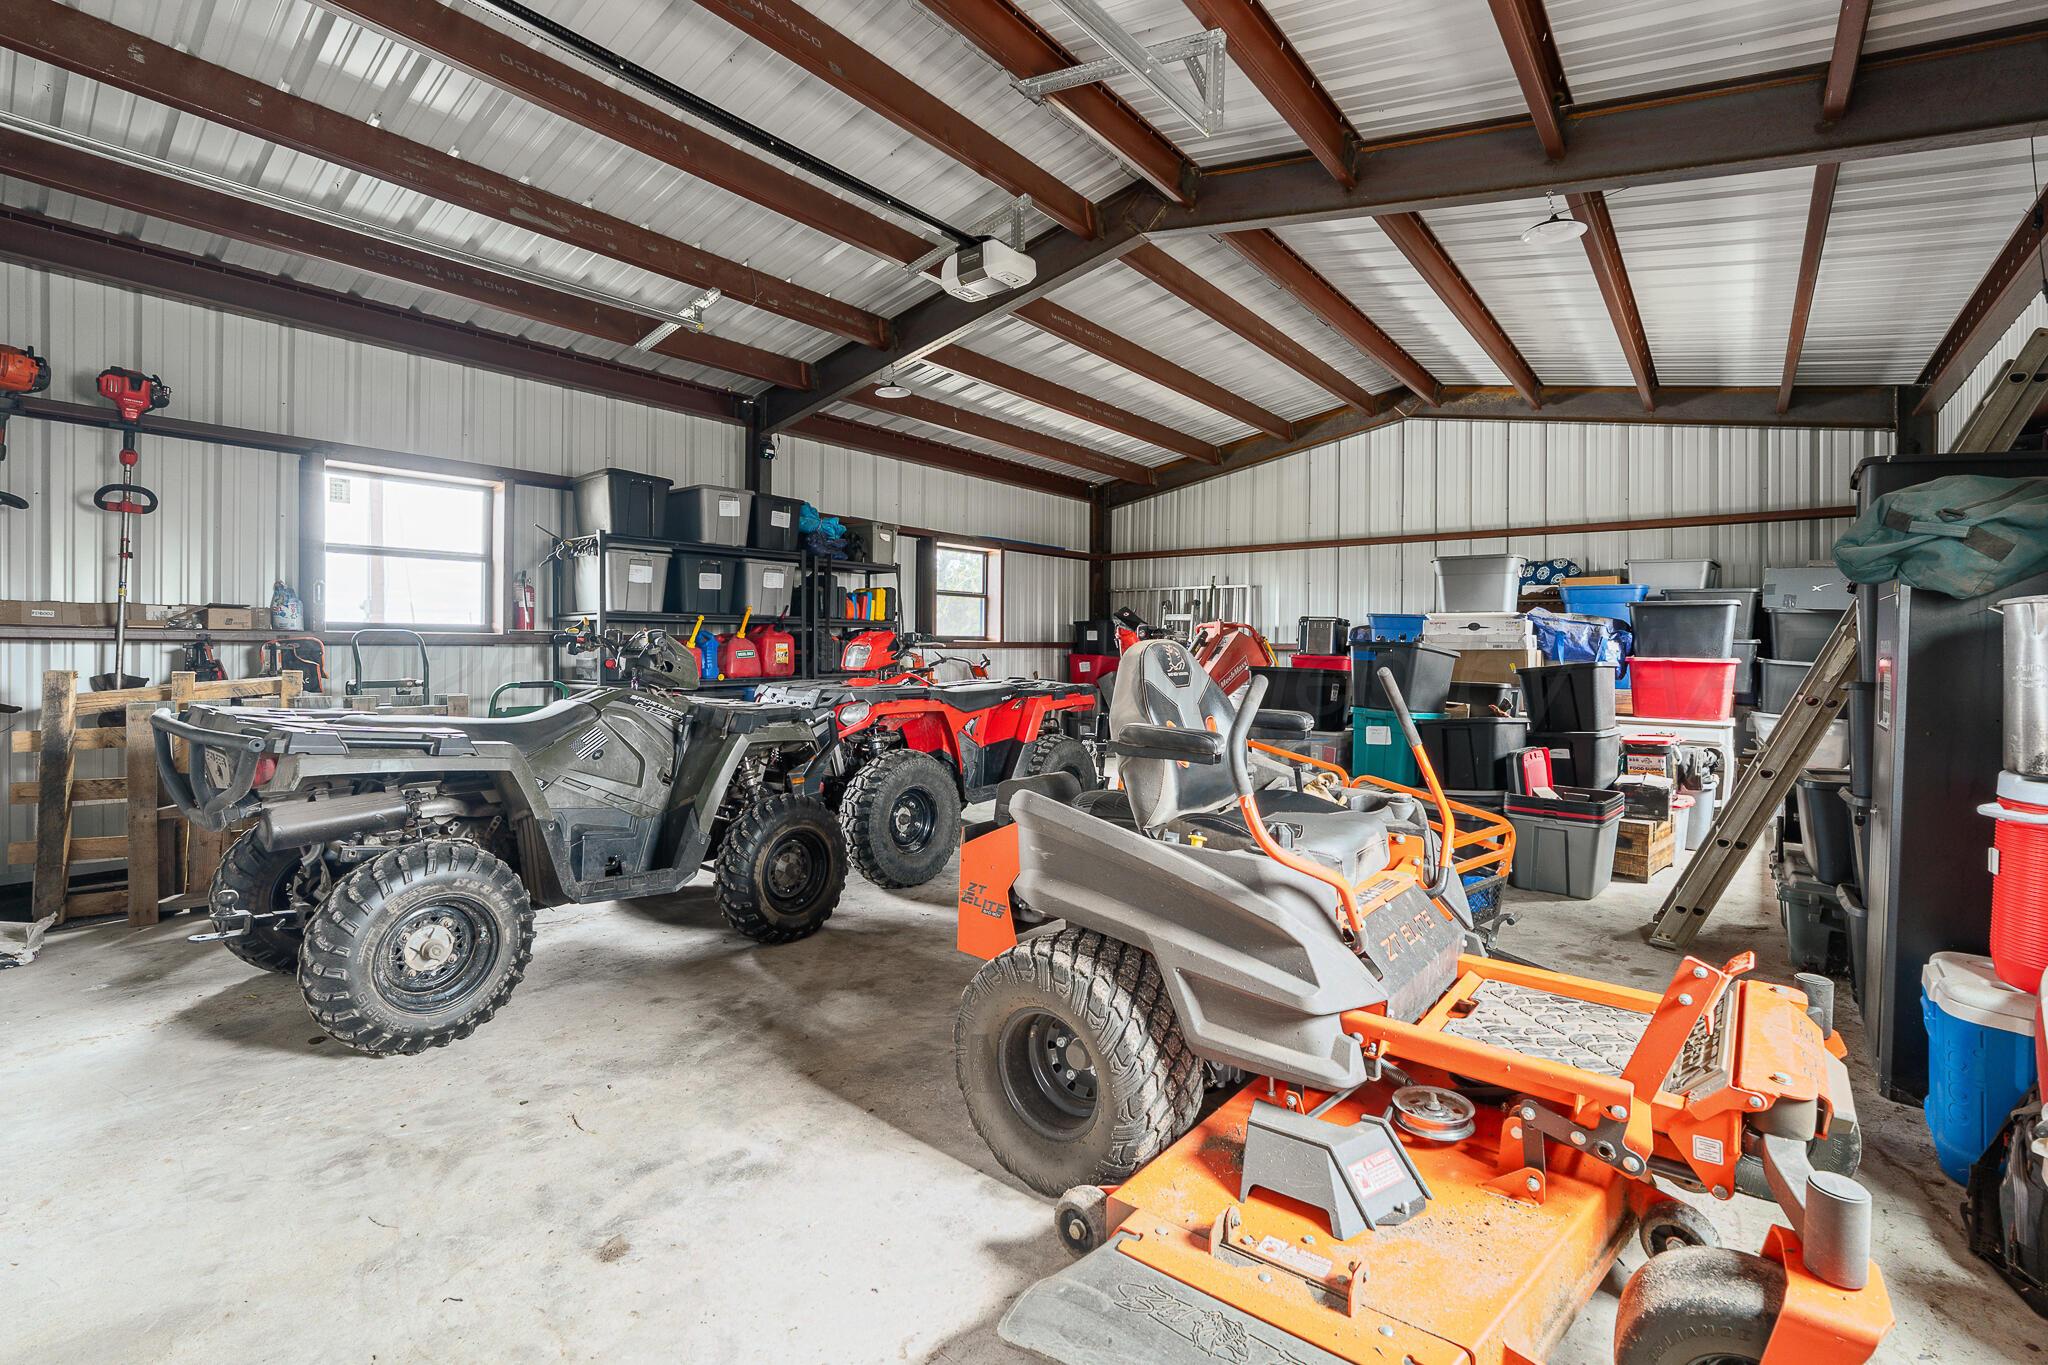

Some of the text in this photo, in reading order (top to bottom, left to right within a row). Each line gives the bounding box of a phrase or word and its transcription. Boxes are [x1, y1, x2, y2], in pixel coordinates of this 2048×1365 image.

[499, 53, 589, 101] MEXICO
[626, 111, 678, 142] MADE
[545, 206, 615, 237] MEXICO
[363, 247, 441, 276] MEXICO
[961, 890, 1008, 915] ELITE
[967, 882, 988, 895] ZT
[1380, 909, 1436, 962] ZT ELITE
